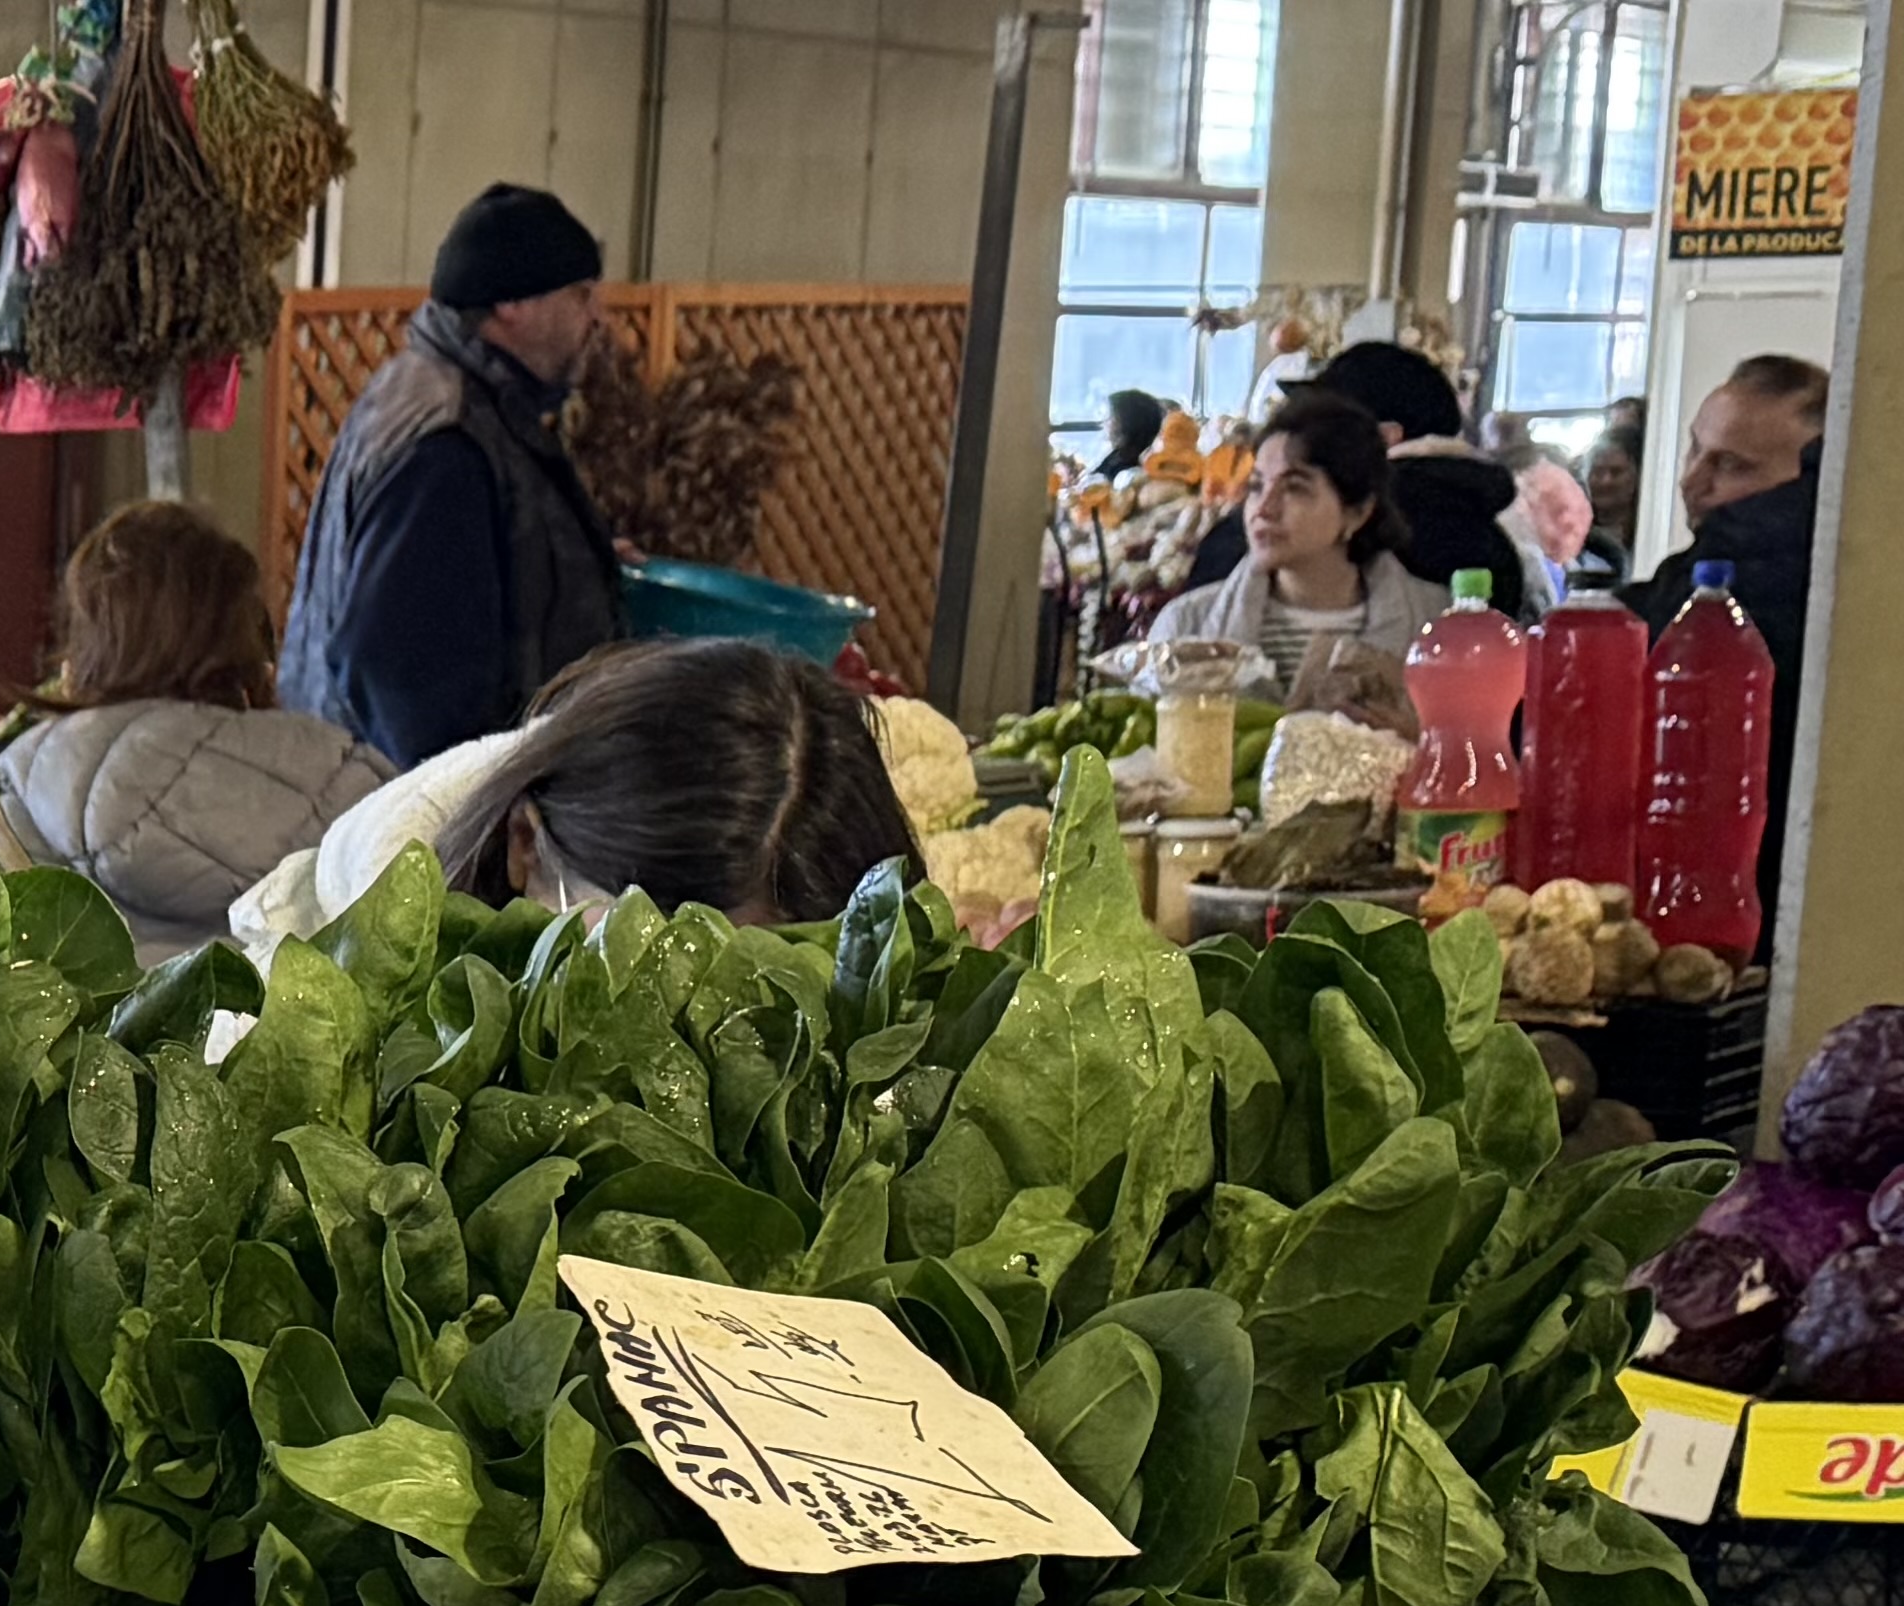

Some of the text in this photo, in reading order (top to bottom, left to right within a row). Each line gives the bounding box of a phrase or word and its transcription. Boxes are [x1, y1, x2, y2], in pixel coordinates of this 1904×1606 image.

[1686, 165, 1832, 219] MIERE
[1679, 230, 1845, 256] DE LA PRODUC
[592, 1298, 762, 1507] SPANAC
